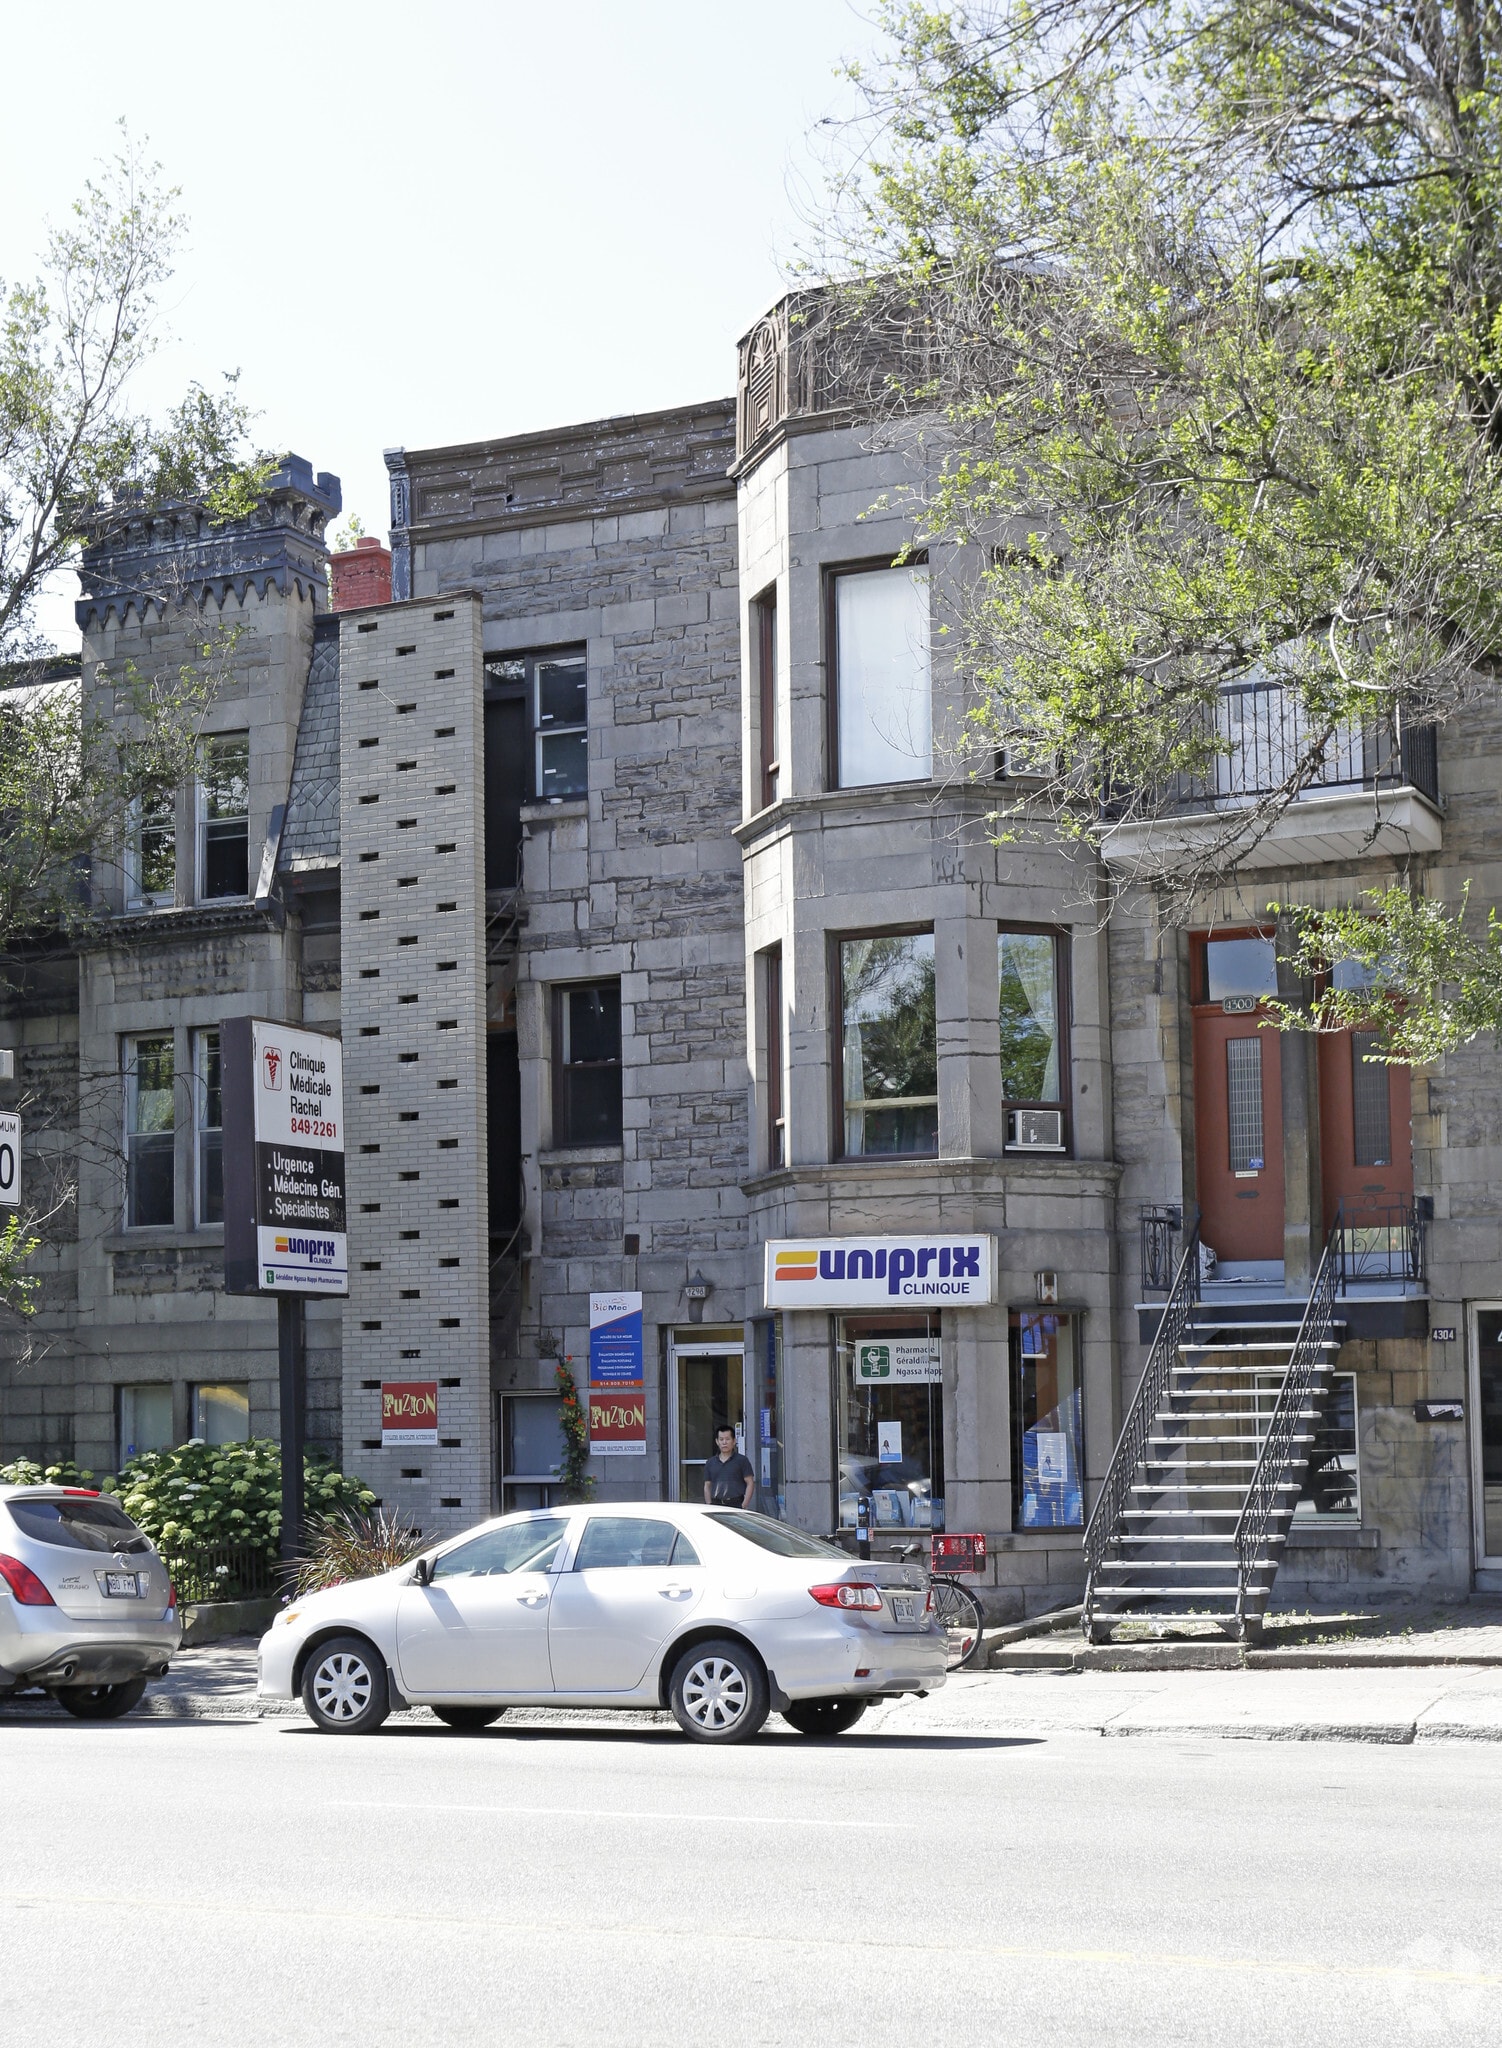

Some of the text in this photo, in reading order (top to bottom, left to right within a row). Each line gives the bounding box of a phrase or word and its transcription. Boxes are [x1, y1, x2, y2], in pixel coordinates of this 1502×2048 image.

[1225, 997, 1253, 1010] 4300
[289, 1050, 326, 1076] Clinique
[289, 1073, 332, 1097] Médicale
[290, 1096, 322, 1117] Rachel
[273, 1151, 314, 1175] Urgence
[274, 1174, 343, 1199] Médecine Gén.
[275, 1196, 330, 1220] Spécialistes
[288, 1237, 335, 1263] uniprix
[820, 1246, 980, 1296] uniprix
[903, 1282, 970, 1295] CLINIQUE
[1433, 1329, 1454, 1340] 4304
[895, 1346, 936, 1354] Pharmace
[896, 1368, 922, 1377] Ngassa
